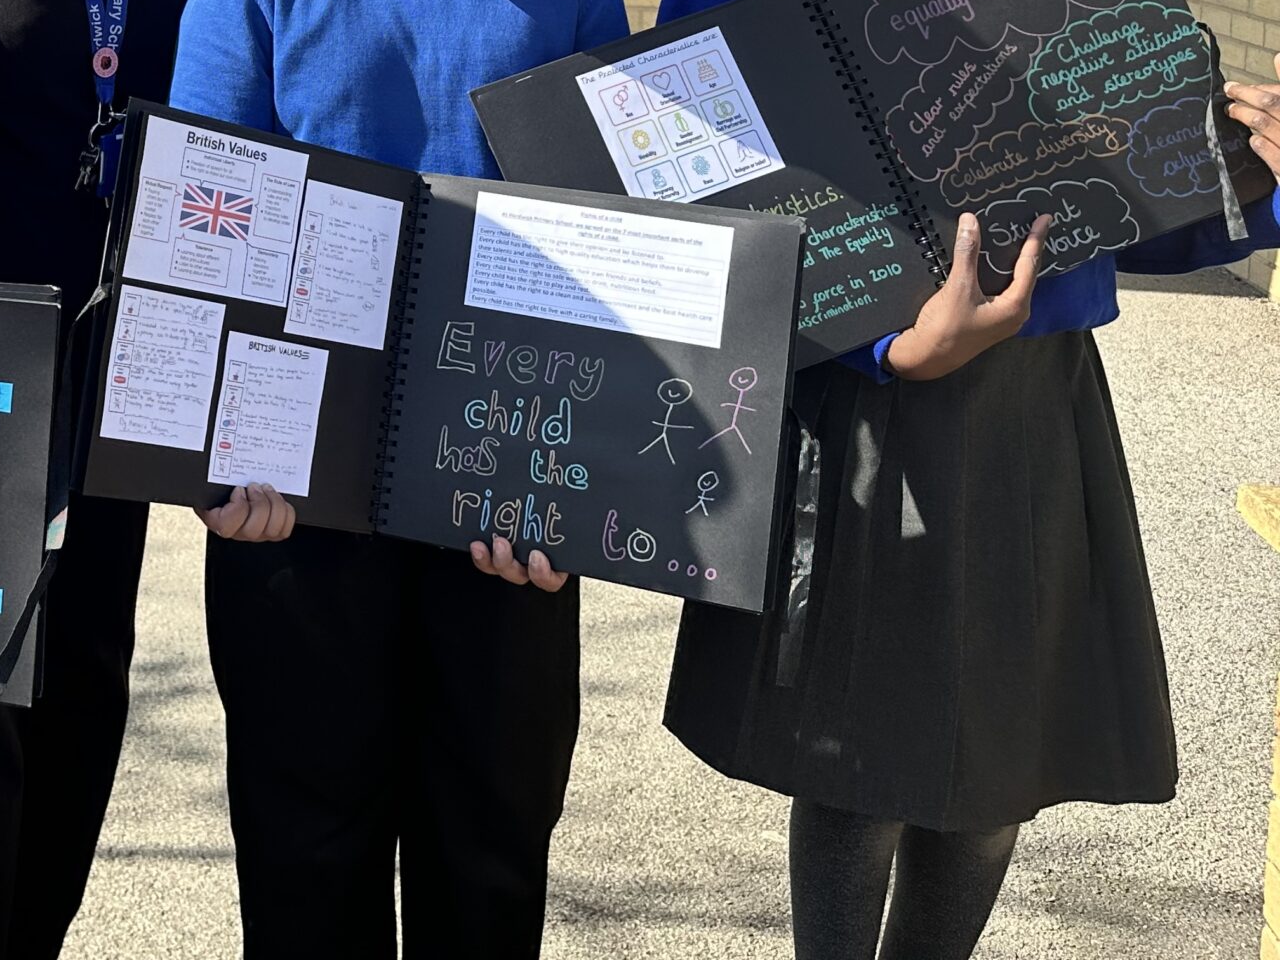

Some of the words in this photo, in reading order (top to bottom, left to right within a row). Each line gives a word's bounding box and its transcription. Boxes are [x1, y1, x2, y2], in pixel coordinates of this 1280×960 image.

[637, 40, 700, 65] Characteristics
[1040, 51, 1115, 93] negative
[1124, 20, 1201, 63] attitudes
[1057, 21, 1145, 63] Challenge
[922, 128, 946, 158] and
[949, 43, 1018, 121] expectations
[949, 62, 977, 97] rules
[1056, 90, 1095, 113] and
[1104, 47, 1198, 93] stereotypes
[187, 131, 225, 152] British
[229, 141, 268, 162] Values
[950, 149, 1029, 188] Celebrate
[1035, 119, 1119, 161] diversity
[808, 203, 899, 246] characteristics
[818, 246, 843, 260] The
[845, 226, 895, 254] Equality
[472, 294, 487, 303] Every
[488, 296, 502, 306] child
[503, 299, 513, 307] has
[514, 301, 524, 309] the
[525, 303, 539, 313] right
[548, 306, 558, 314] live
[560, 308, 573, 316] with
[579, 312, 598, 323] caring
[813, 283, 846, 313] force
[847, 274, 865, 289] in
[869, 263, 903, 283] 2010
[248, 341, 276, 353] BRITISH
[279, 344, 304, 359] VALUES
[437, 321, 604, 401] Every
[464, 390, 571, 445] child
[436, 425, 501, 476] has
[531, 449, 589, 490] the
[452, 489, 566, 545] right
